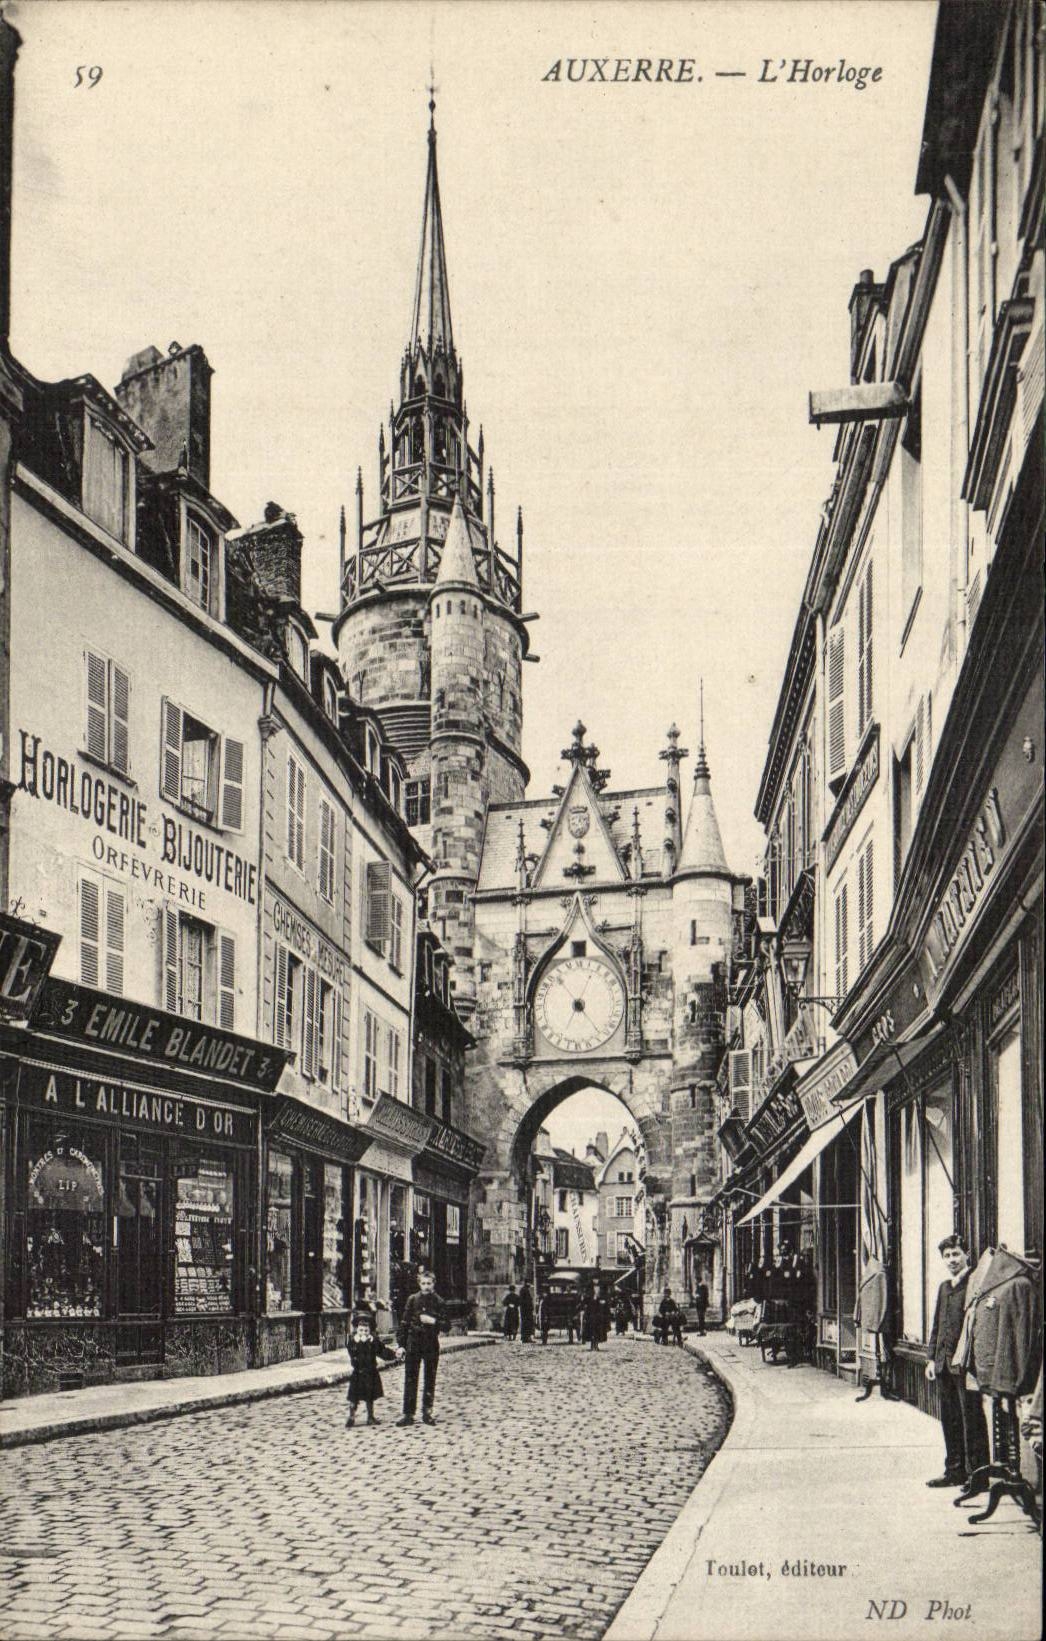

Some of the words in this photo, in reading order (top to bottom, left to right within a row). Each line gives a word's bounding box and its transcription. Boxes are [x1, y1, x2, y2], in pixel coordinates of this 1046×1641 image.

[19, 729, 147, 849] HORLOGERIE
[160, 813, 258, 906] BIJOUTERIE
[273, 901, 311, 958] CHEMISES
[61, 999, 79, 1025] 3
[84, 1003, 160, 1052] EMILE
[164, 1027, 255, 1077] BLANDET
[45, 1075, 58, 1103] A
[75, 1080, 184, 1126] L'ALLIANCE
[196, 1110, 234, 1136] D'OR
[58, 1179, 77, 1191] LIP
[173, 1165, 196, 1177] LIP
